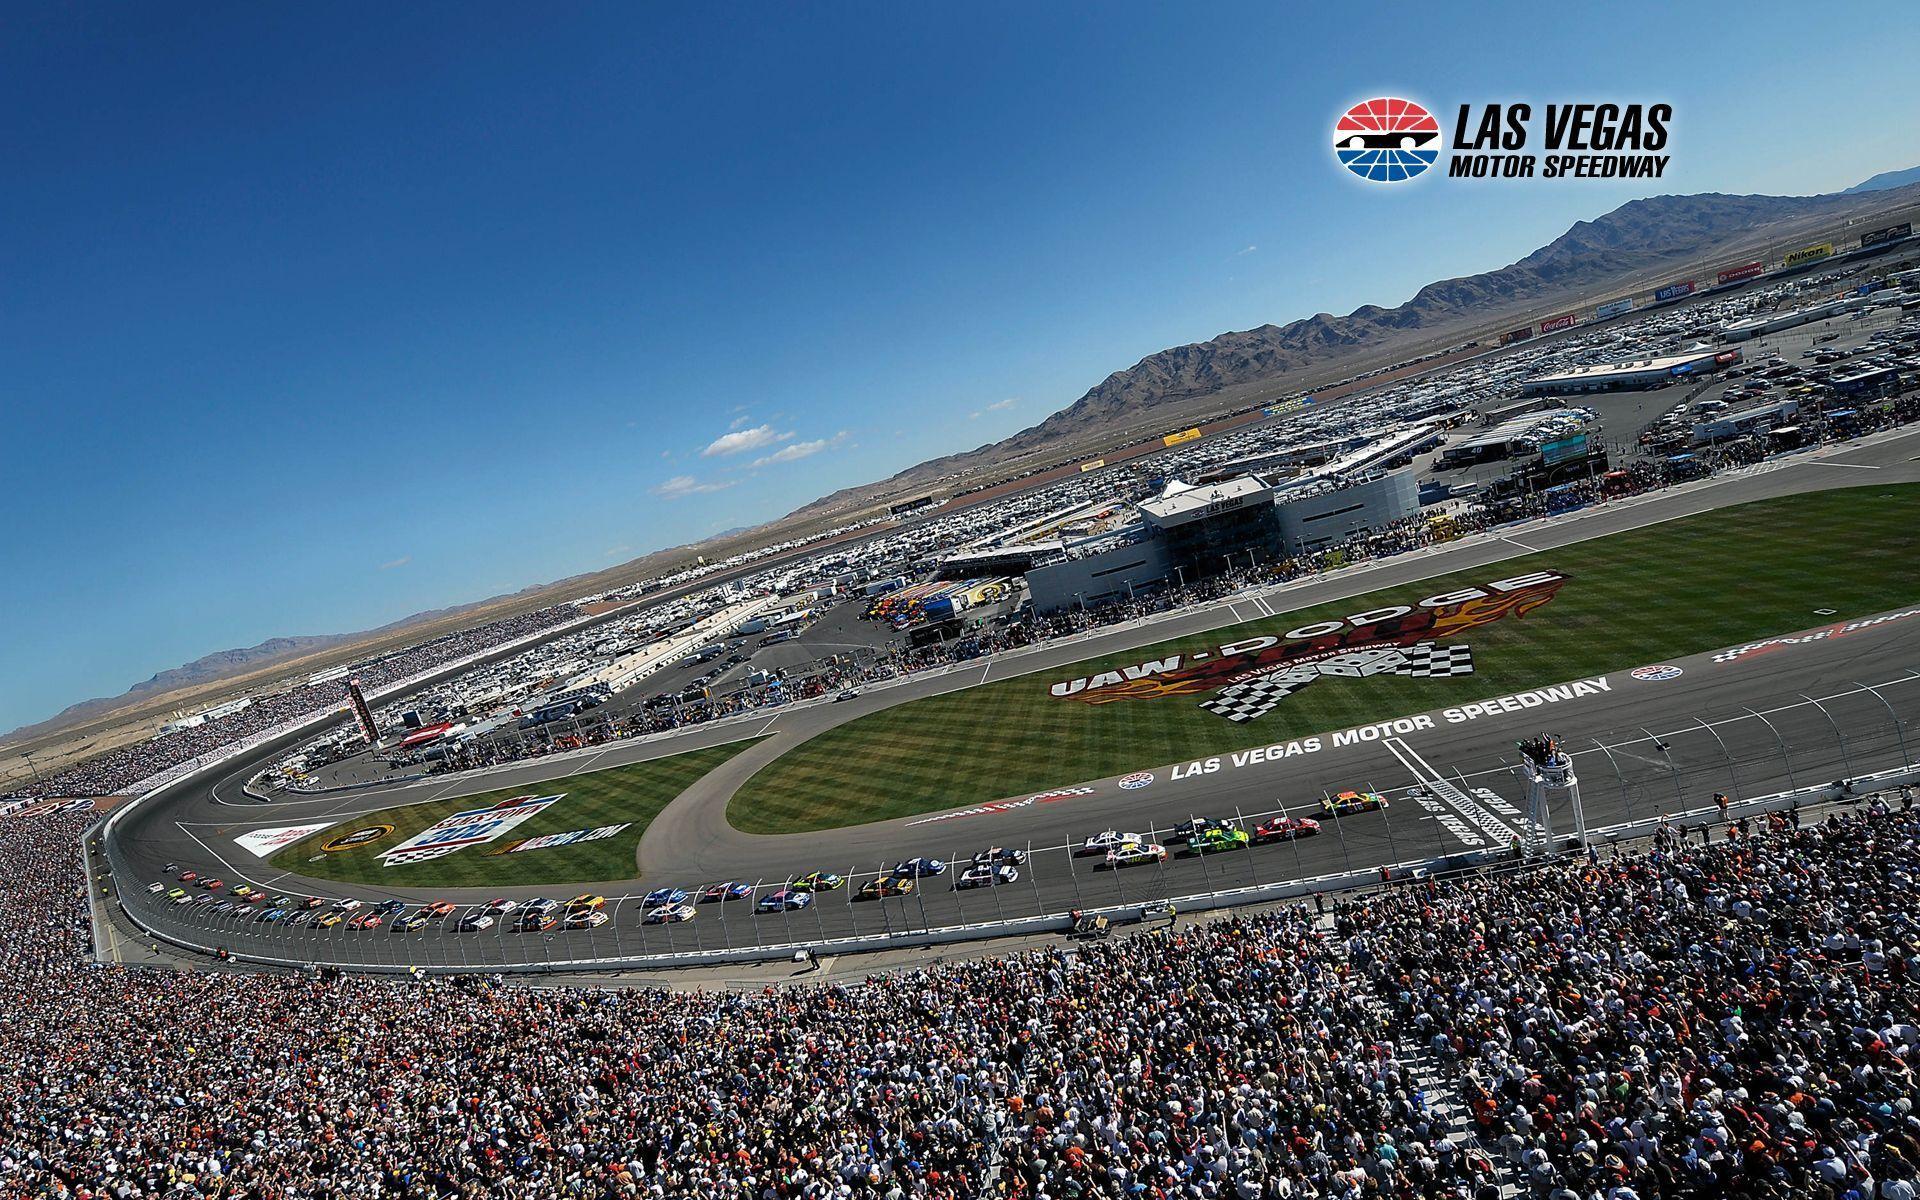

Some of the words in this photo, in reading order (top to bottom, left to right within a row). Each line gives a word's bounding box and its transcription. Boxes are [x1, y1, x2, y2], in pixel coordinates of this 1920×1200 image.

[1788, 248, 1823, 263] Nikon
[1206, 503, 1220, 513] LAS
[1220, 497, 1244, 510] VEGAS
[1227, 671, 1252, 684] LAS
[1253, 660, 1293, 676] VEGAS
[1293, 651, 1336, 664] MOTOR
[1338, 641, 1401, 655] SPEEDWAY
[1170, 757, 1221, 781] LAS
[1231, 737, 1322, 768] VEGAS
[1331, 714, 1436, 748] MOTOR
[1442, 676, 1613, 724] SPEEDWAY
[1413, 796, 1446, 812] LAS
[1435, 813, 1486, 846] VEGAS
